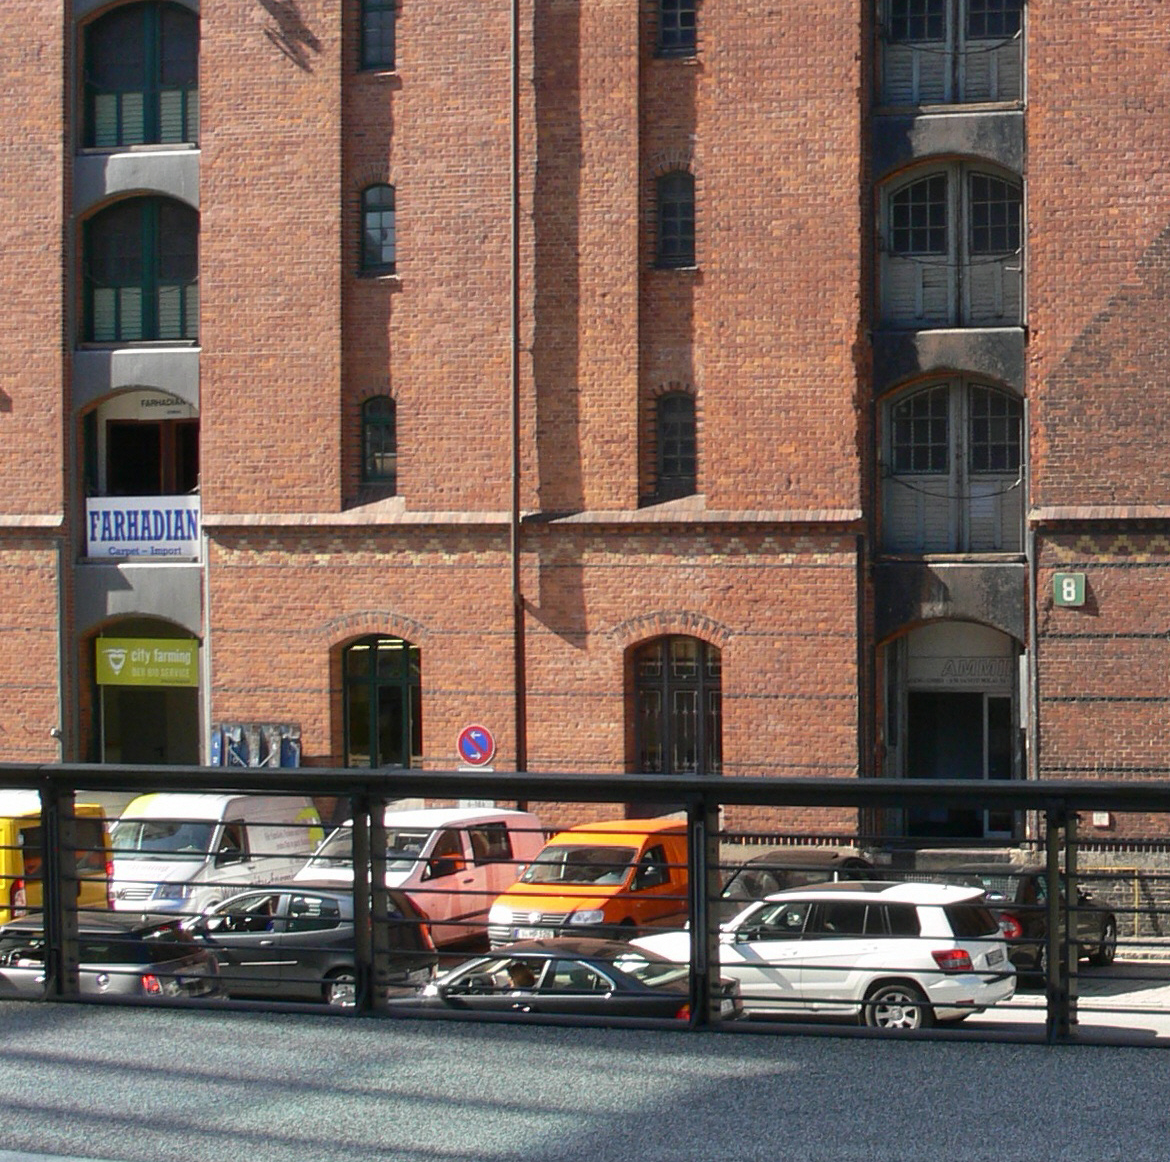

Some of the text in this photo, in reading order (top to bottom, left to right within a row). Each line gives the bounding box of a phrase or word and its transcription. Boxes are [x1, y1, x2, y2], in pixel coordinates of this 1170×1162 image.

[89, 509, 198, 542] FARHADIAN
[108, 546, 139, 557] Carpet
[150, 546, 182, 556] Import
[1062, 577, 1076, 602] 8
[131, 648, 191, 666] city farming
